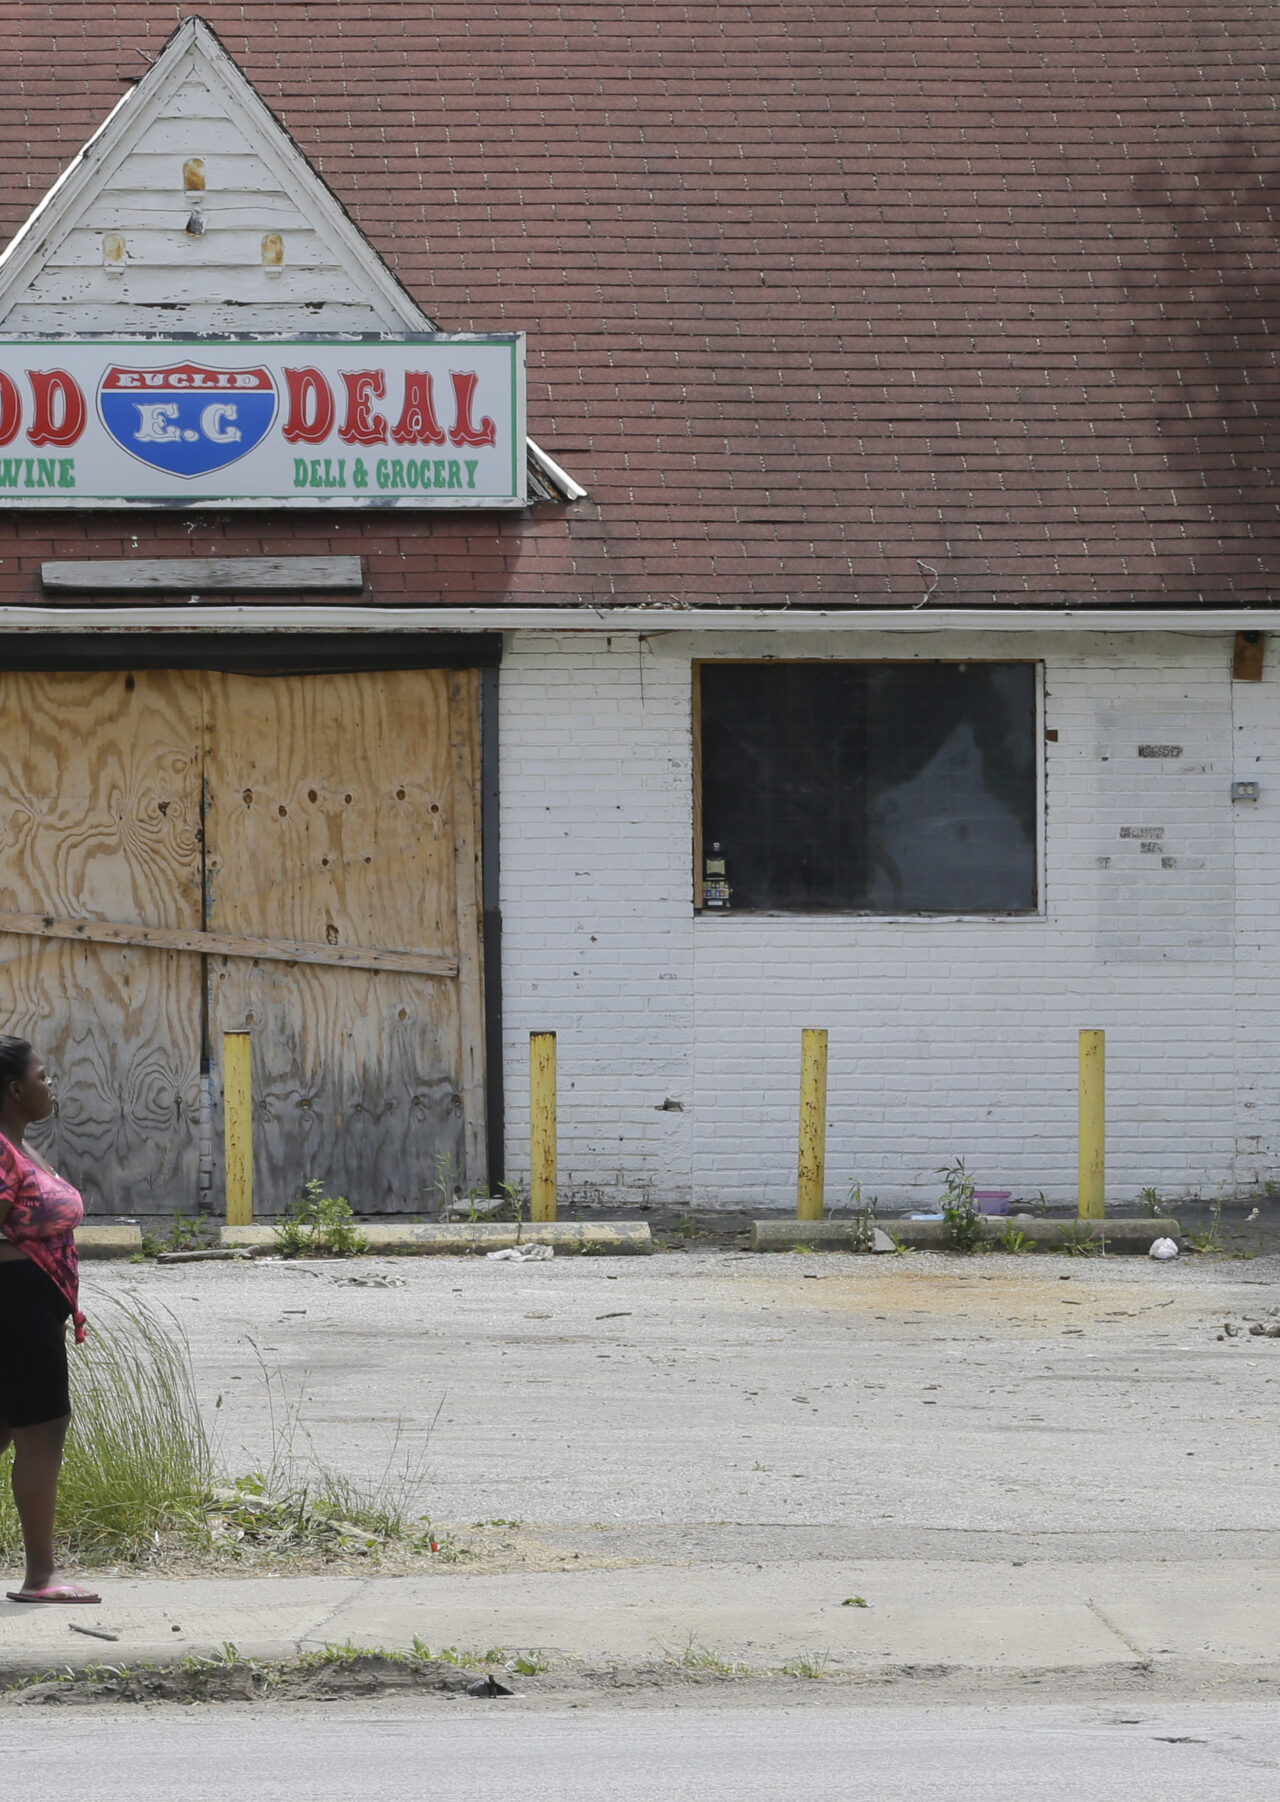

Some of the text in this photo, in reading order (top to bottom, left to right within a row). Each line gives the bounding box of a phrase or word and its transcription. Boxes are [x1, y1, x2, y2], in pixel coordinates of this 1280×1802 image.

[116, 373, 260, 388] EUCLID
[281, 366, 496, 448] DEAL
[293, 457, 479, 489] DELI & GROCERY
